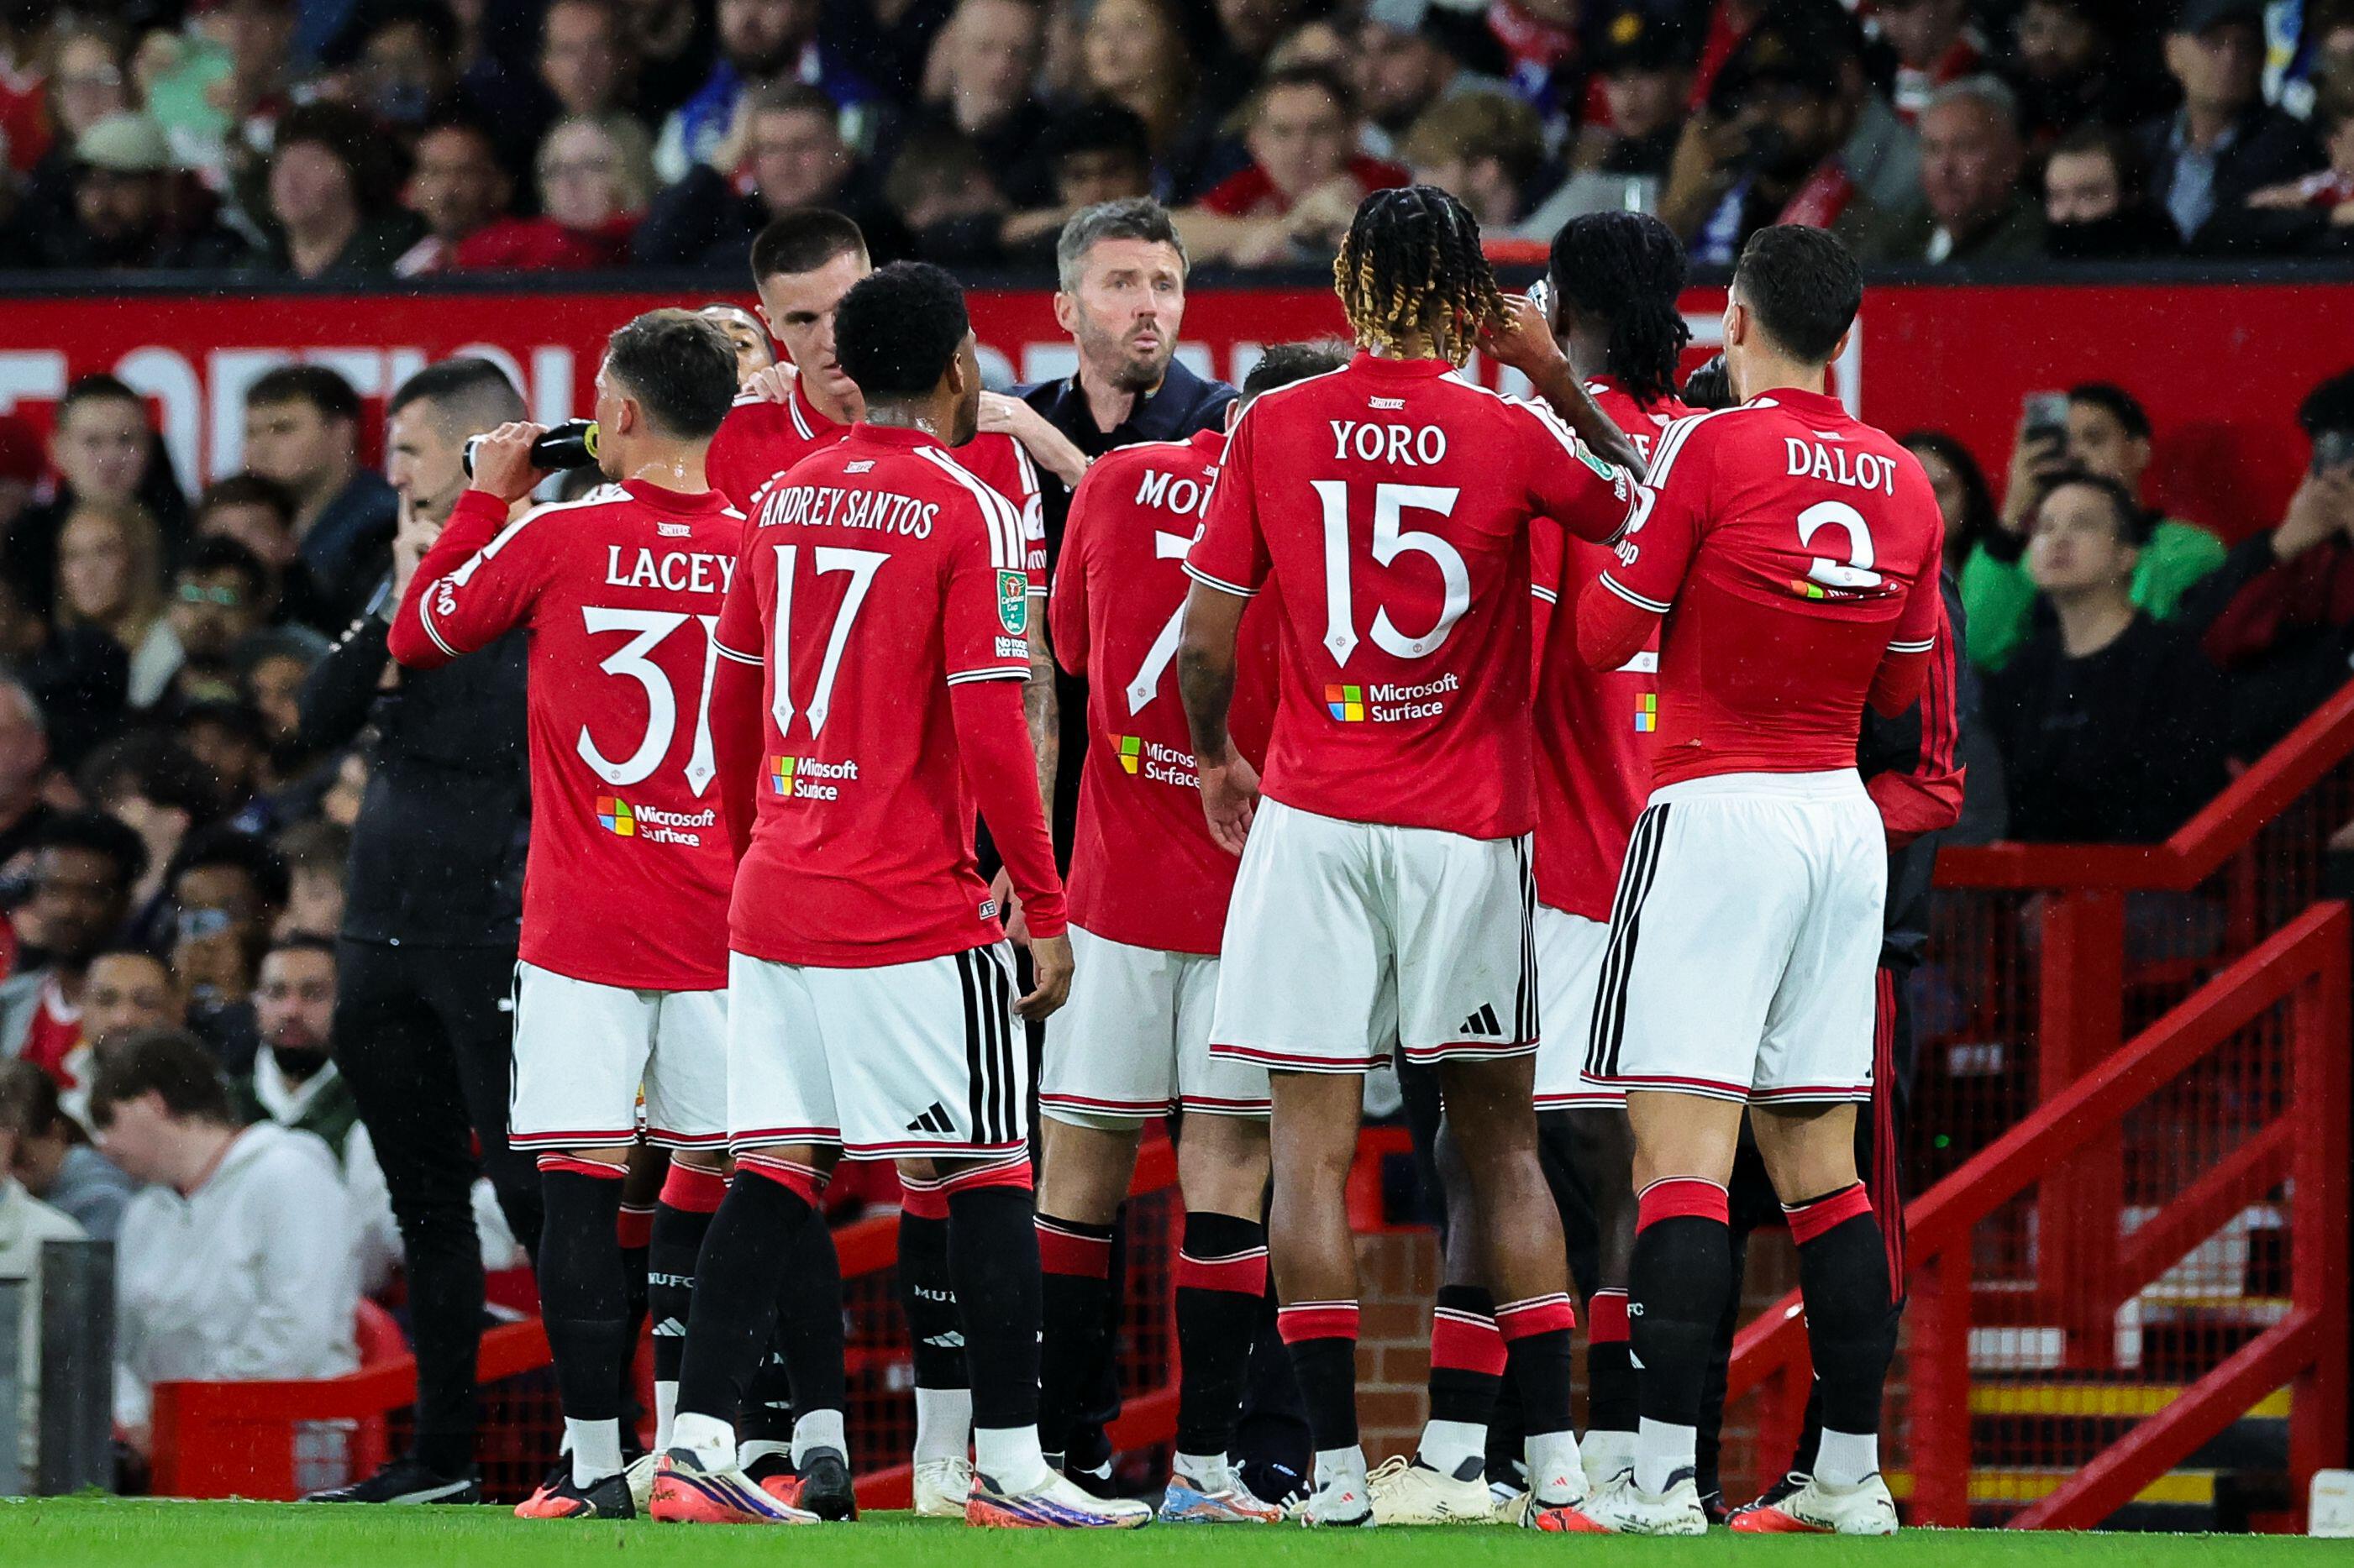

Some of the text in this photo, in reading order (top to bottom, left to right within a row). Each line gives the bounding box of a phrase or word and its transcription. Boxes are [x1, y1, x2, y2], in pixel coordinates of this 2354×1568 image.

[1329, 420, 1447, 466] YORO
[1784, 438, 1896, 496] DALOT
[759, 486, 939, 539] ANDREY SANTOS
[605, 545, 736, 593] LACEY
[1310, 480, 1470, 669] 15
[772, 544, 891, 741] 17
[577, 606, 719, 798] 31
[1369, 673, 1458, 702] Microsoft
[1371, 701, 1443, 722] Surface
[634, 805, 716, 827] Microsoft
[640, 824, 700, 847] Surface
